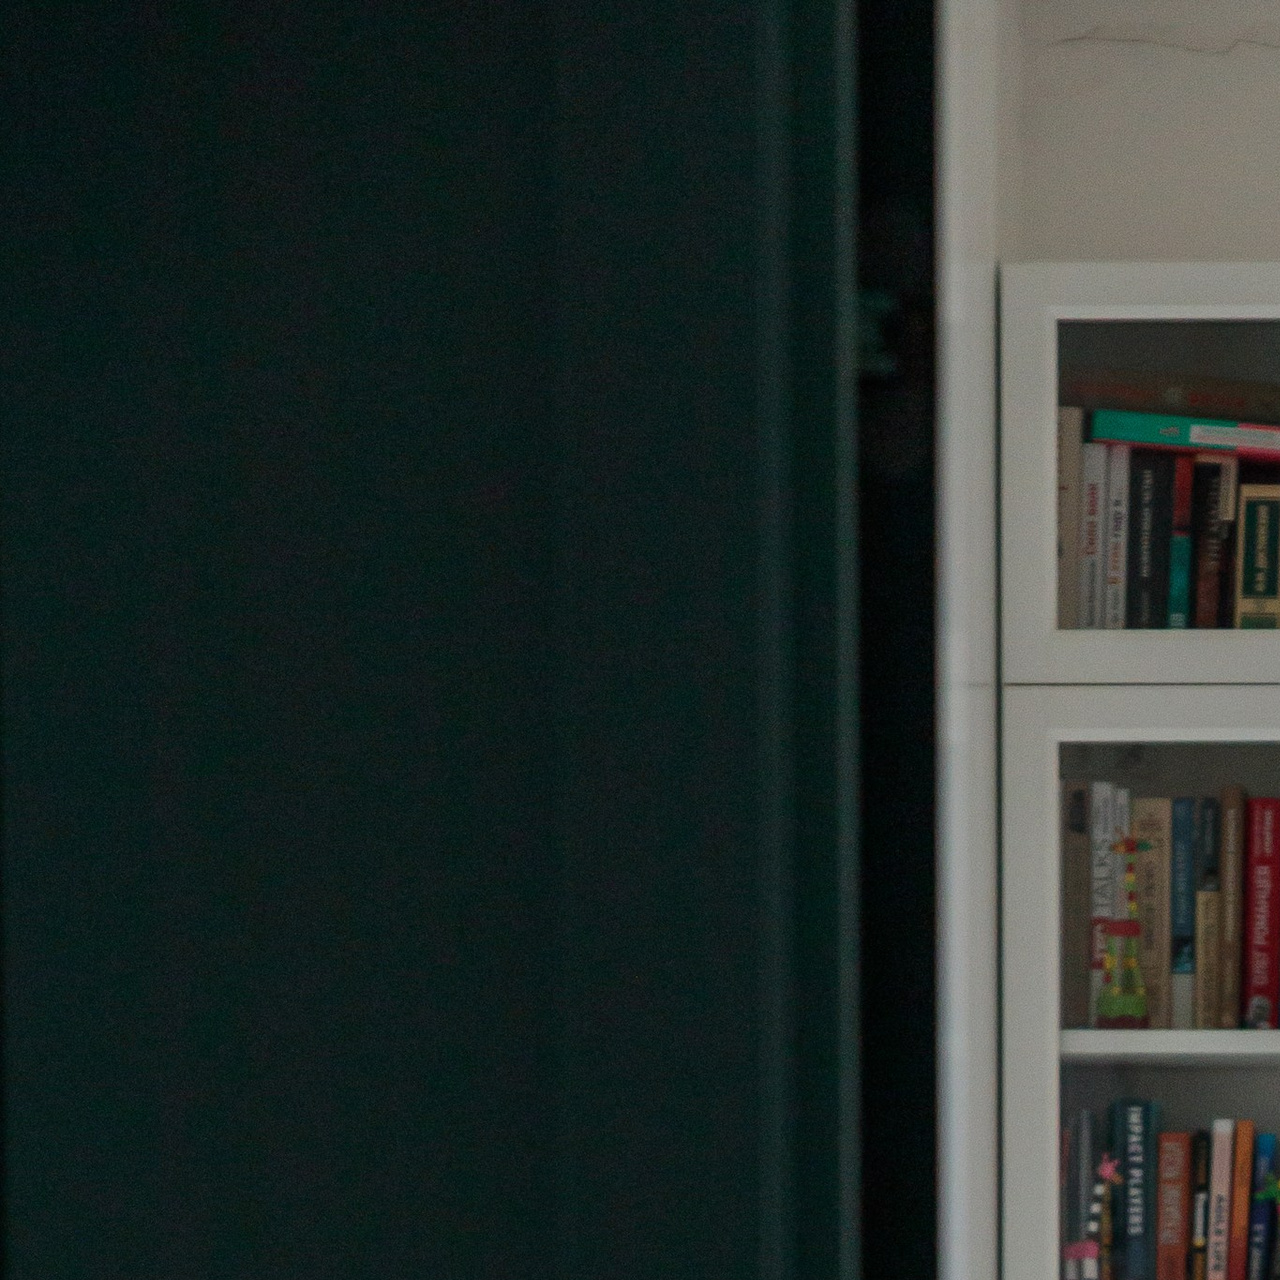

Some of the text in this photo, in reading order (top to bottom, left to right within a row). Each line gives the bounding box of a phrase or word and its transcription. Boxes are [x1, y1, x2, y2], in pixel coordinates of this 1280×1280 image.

[1093, 838, 1113, 908] TALKS
[1127, 1105, 1144, 1236] IMPACT PLAYERS
